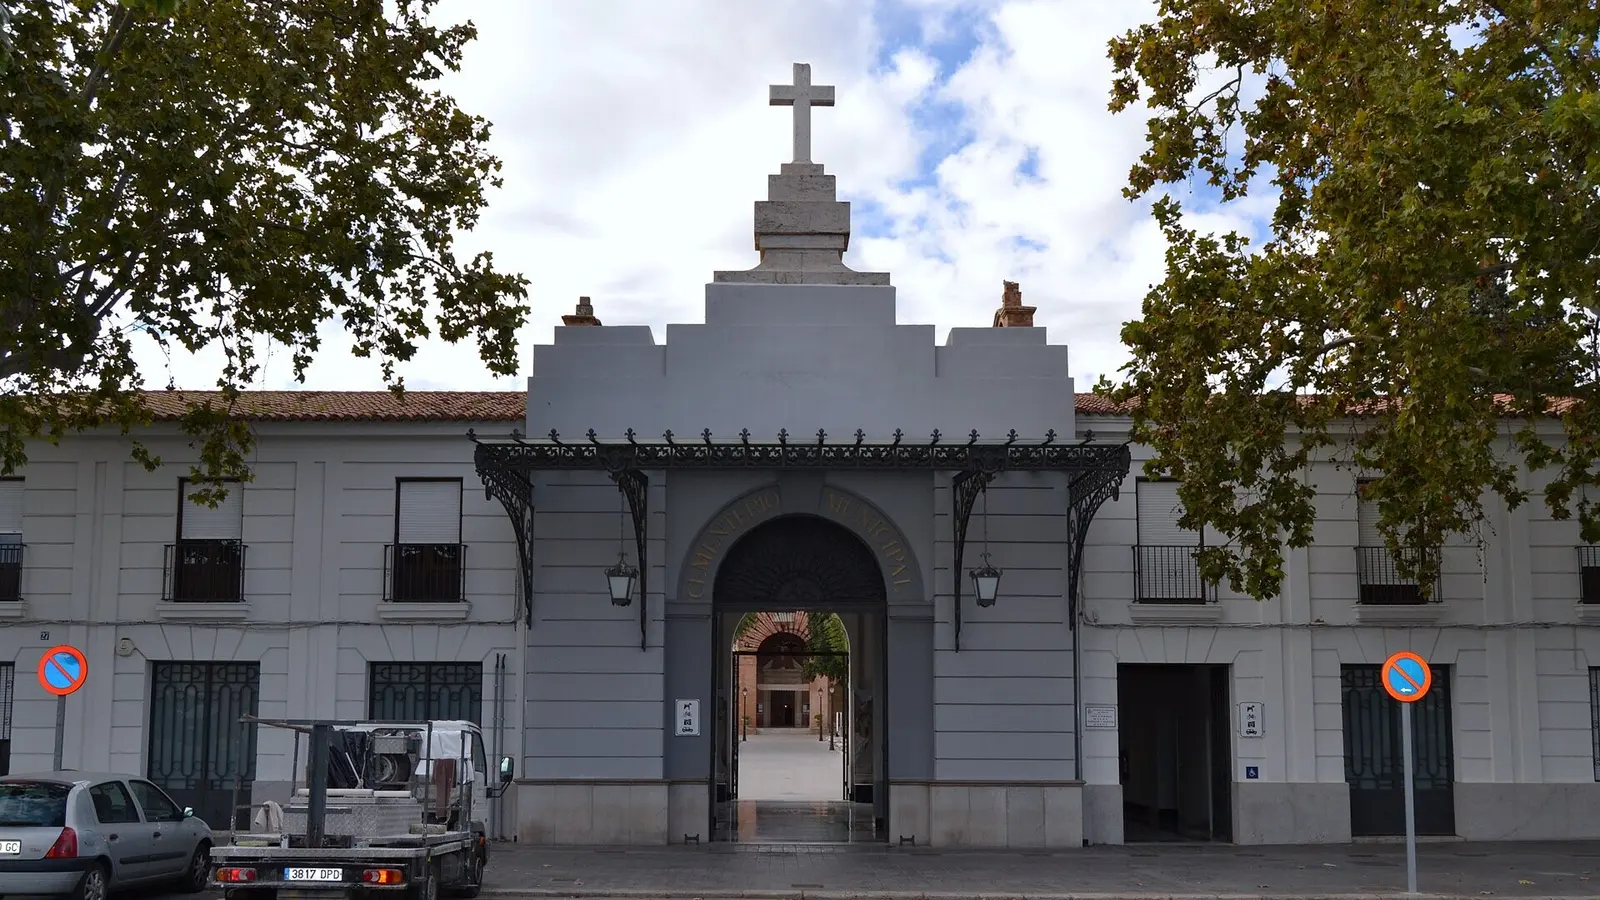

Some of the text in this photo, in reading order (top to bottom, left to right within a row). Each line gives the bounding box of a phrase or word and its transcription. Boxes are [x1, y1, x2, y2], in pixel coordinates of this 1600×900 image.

[686, 490, 912, 600] CEMENTERIO MUNICIPAL
[5, 842, 18, 852] GC
[292, 869, 316, 879] 3817
[320, 869, 340, 879] DPD
